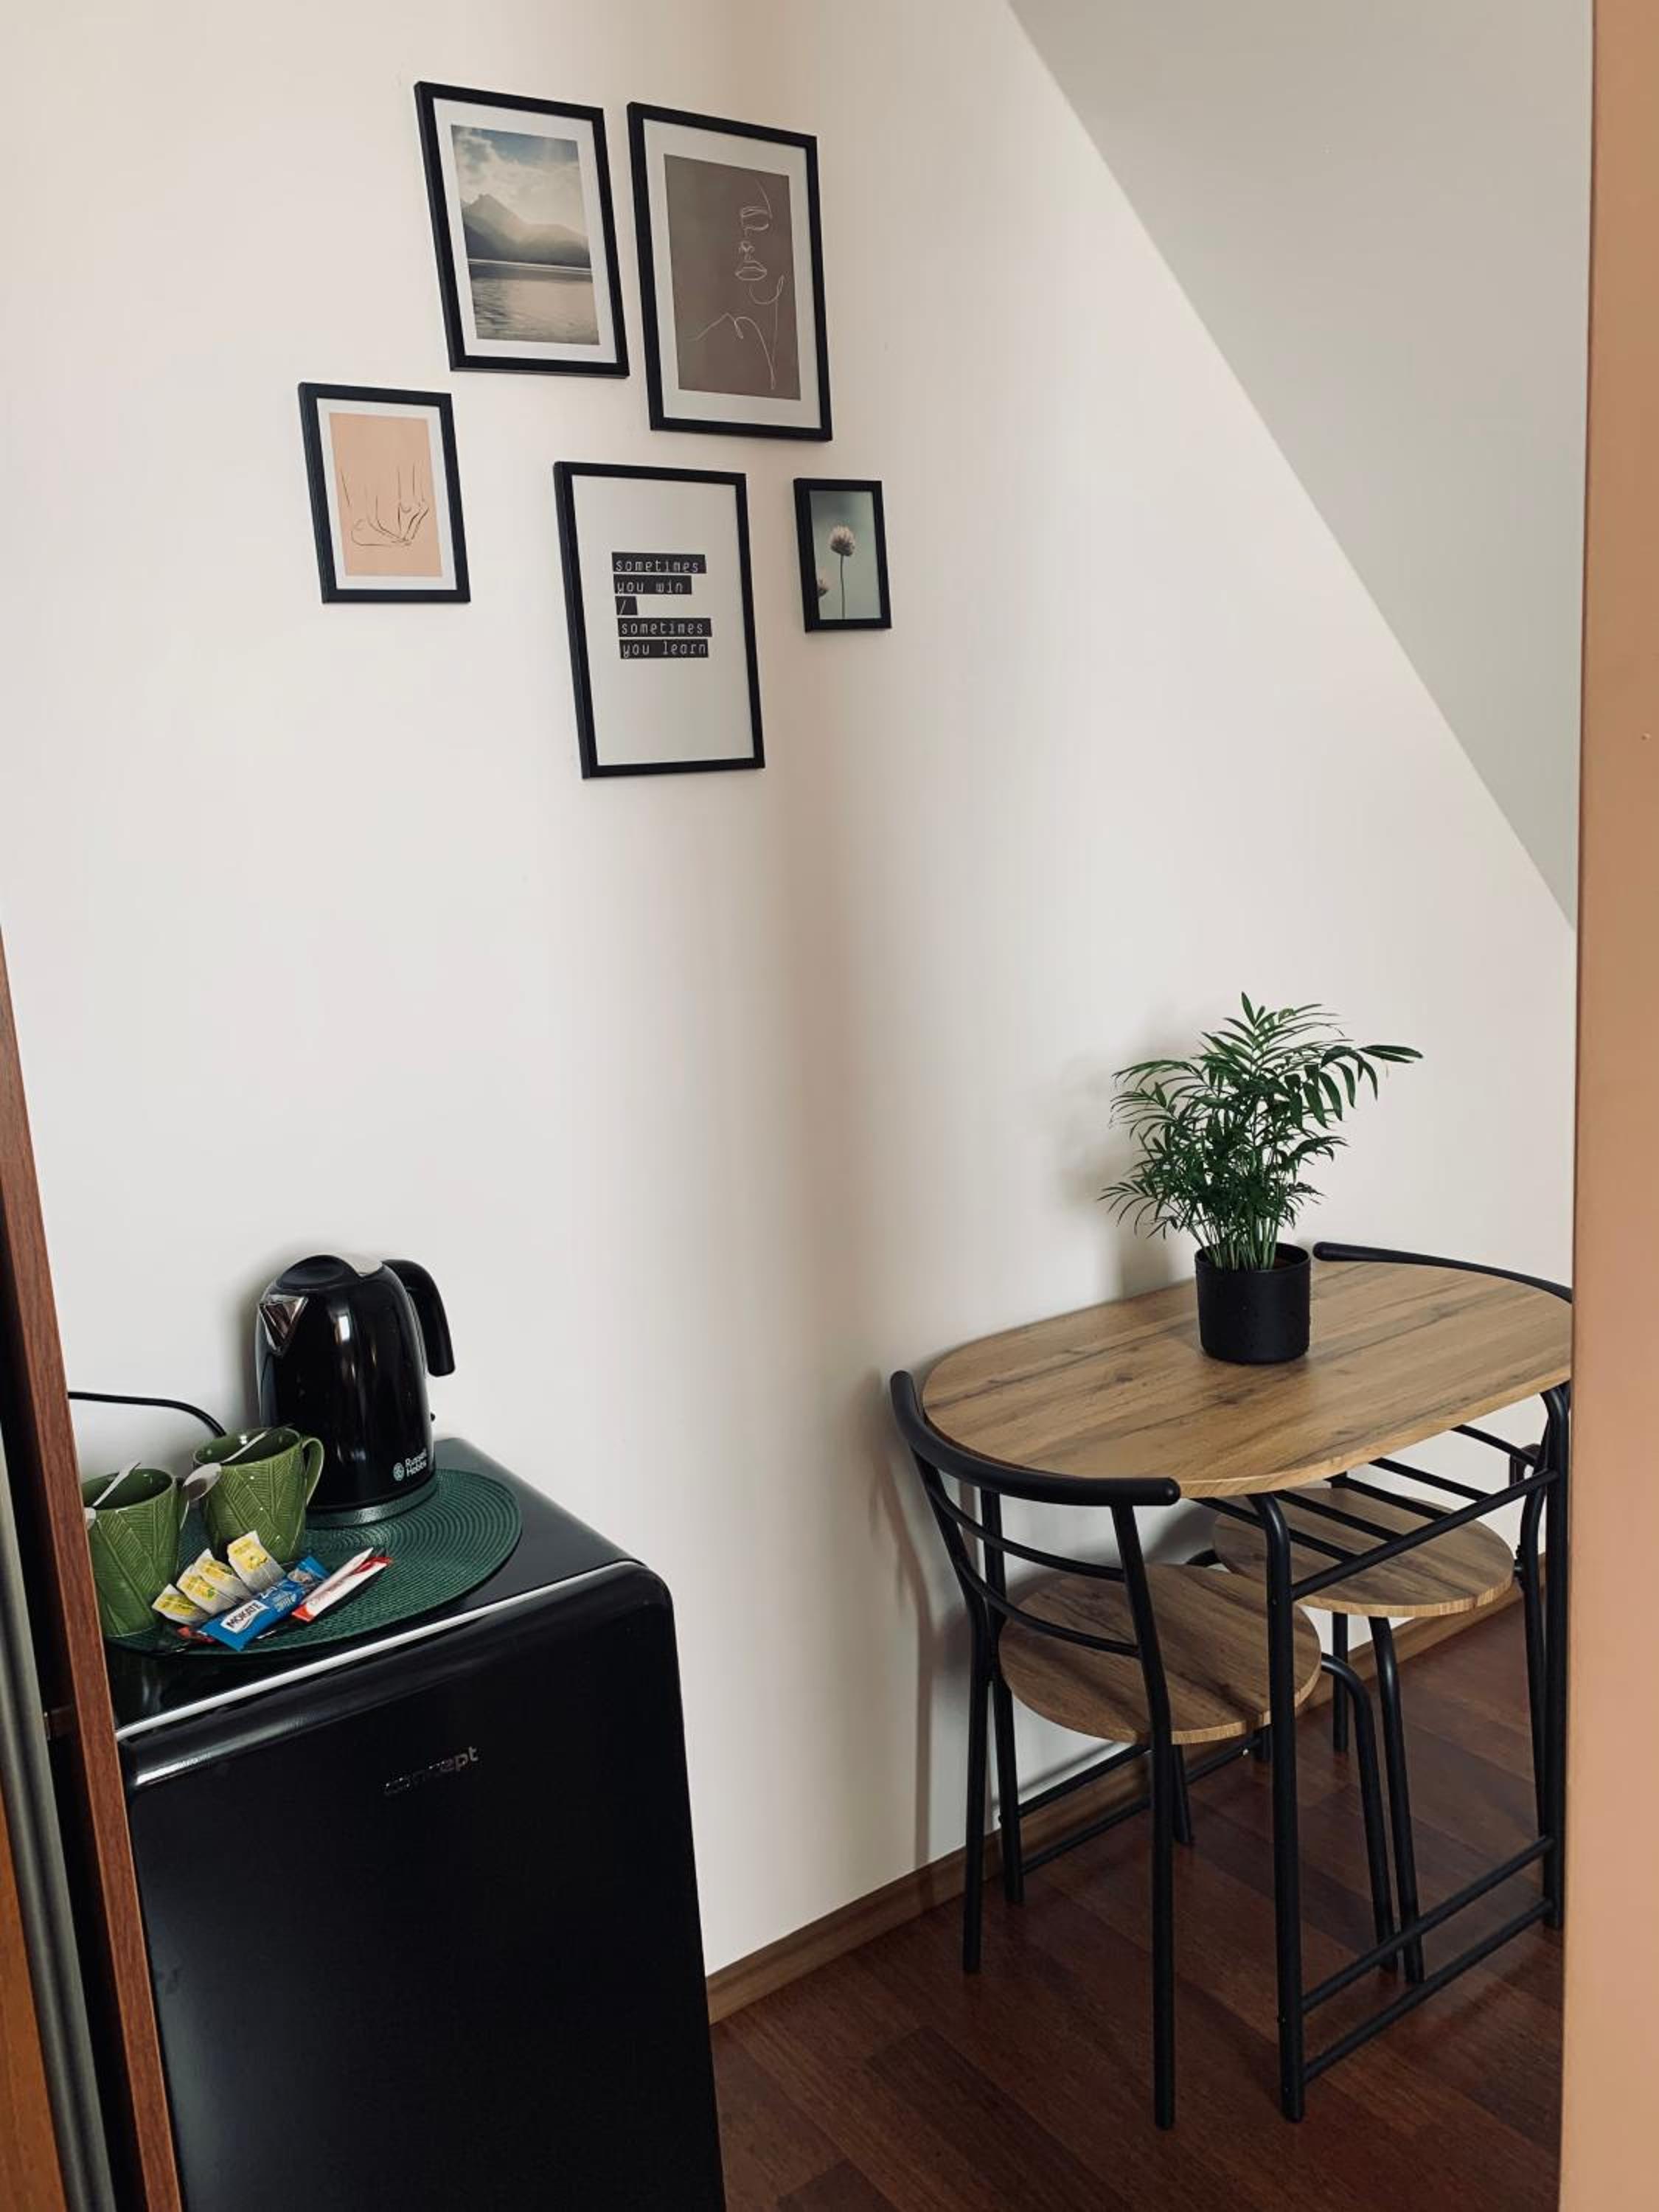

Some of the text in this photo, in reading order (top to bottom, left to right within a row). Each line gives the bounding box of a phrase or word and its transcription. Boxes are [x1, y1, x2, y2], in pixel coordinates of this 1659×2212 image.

[615, 560, 699, 573] sometimes
[616, 580, 684, 594] you win
[619, 599, 627, 615] /
[621, 621, 703, 634] sometimes
[622, 641, 706, 658] you learn
[226, 1599, 263, 1628] MOKATE
